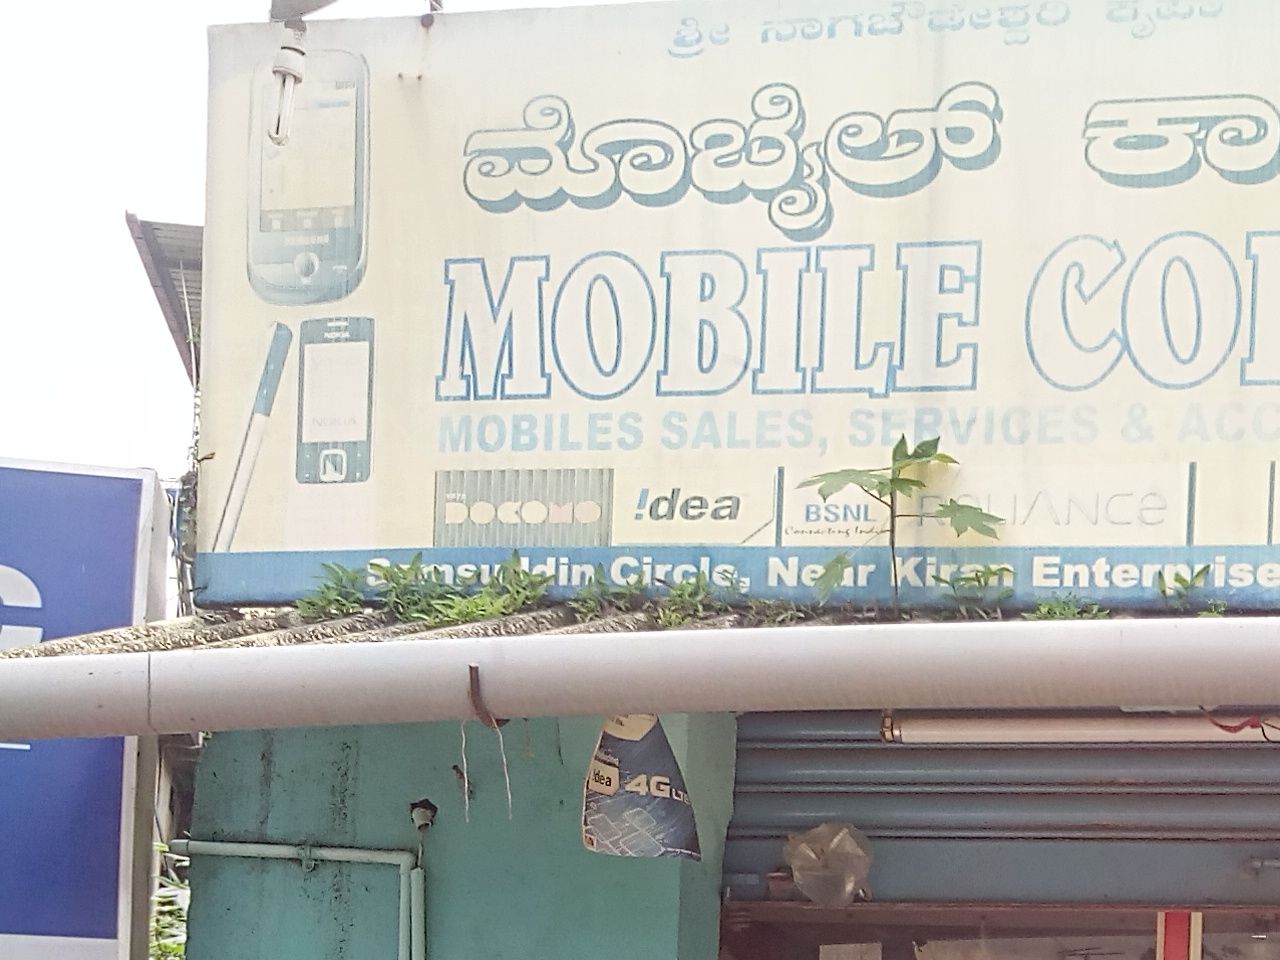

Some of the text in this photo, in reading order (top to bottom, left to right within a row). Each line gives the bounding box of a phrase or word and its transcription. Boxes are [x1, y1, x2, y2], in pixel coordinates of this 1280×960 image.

[435, 240, 982, 400] MOBILE
[438, 411, 644, 453] MOBILES
[660, 408, 828, 455] SALES,
[848, 404, 1098, 448] SERVICES
[1121, 405, 1154, 443] &
[445, 500, 601, 525] DOCOMO
[805, 503, 876, 522] BSNL
[625, 773, 671, 799] 4G
